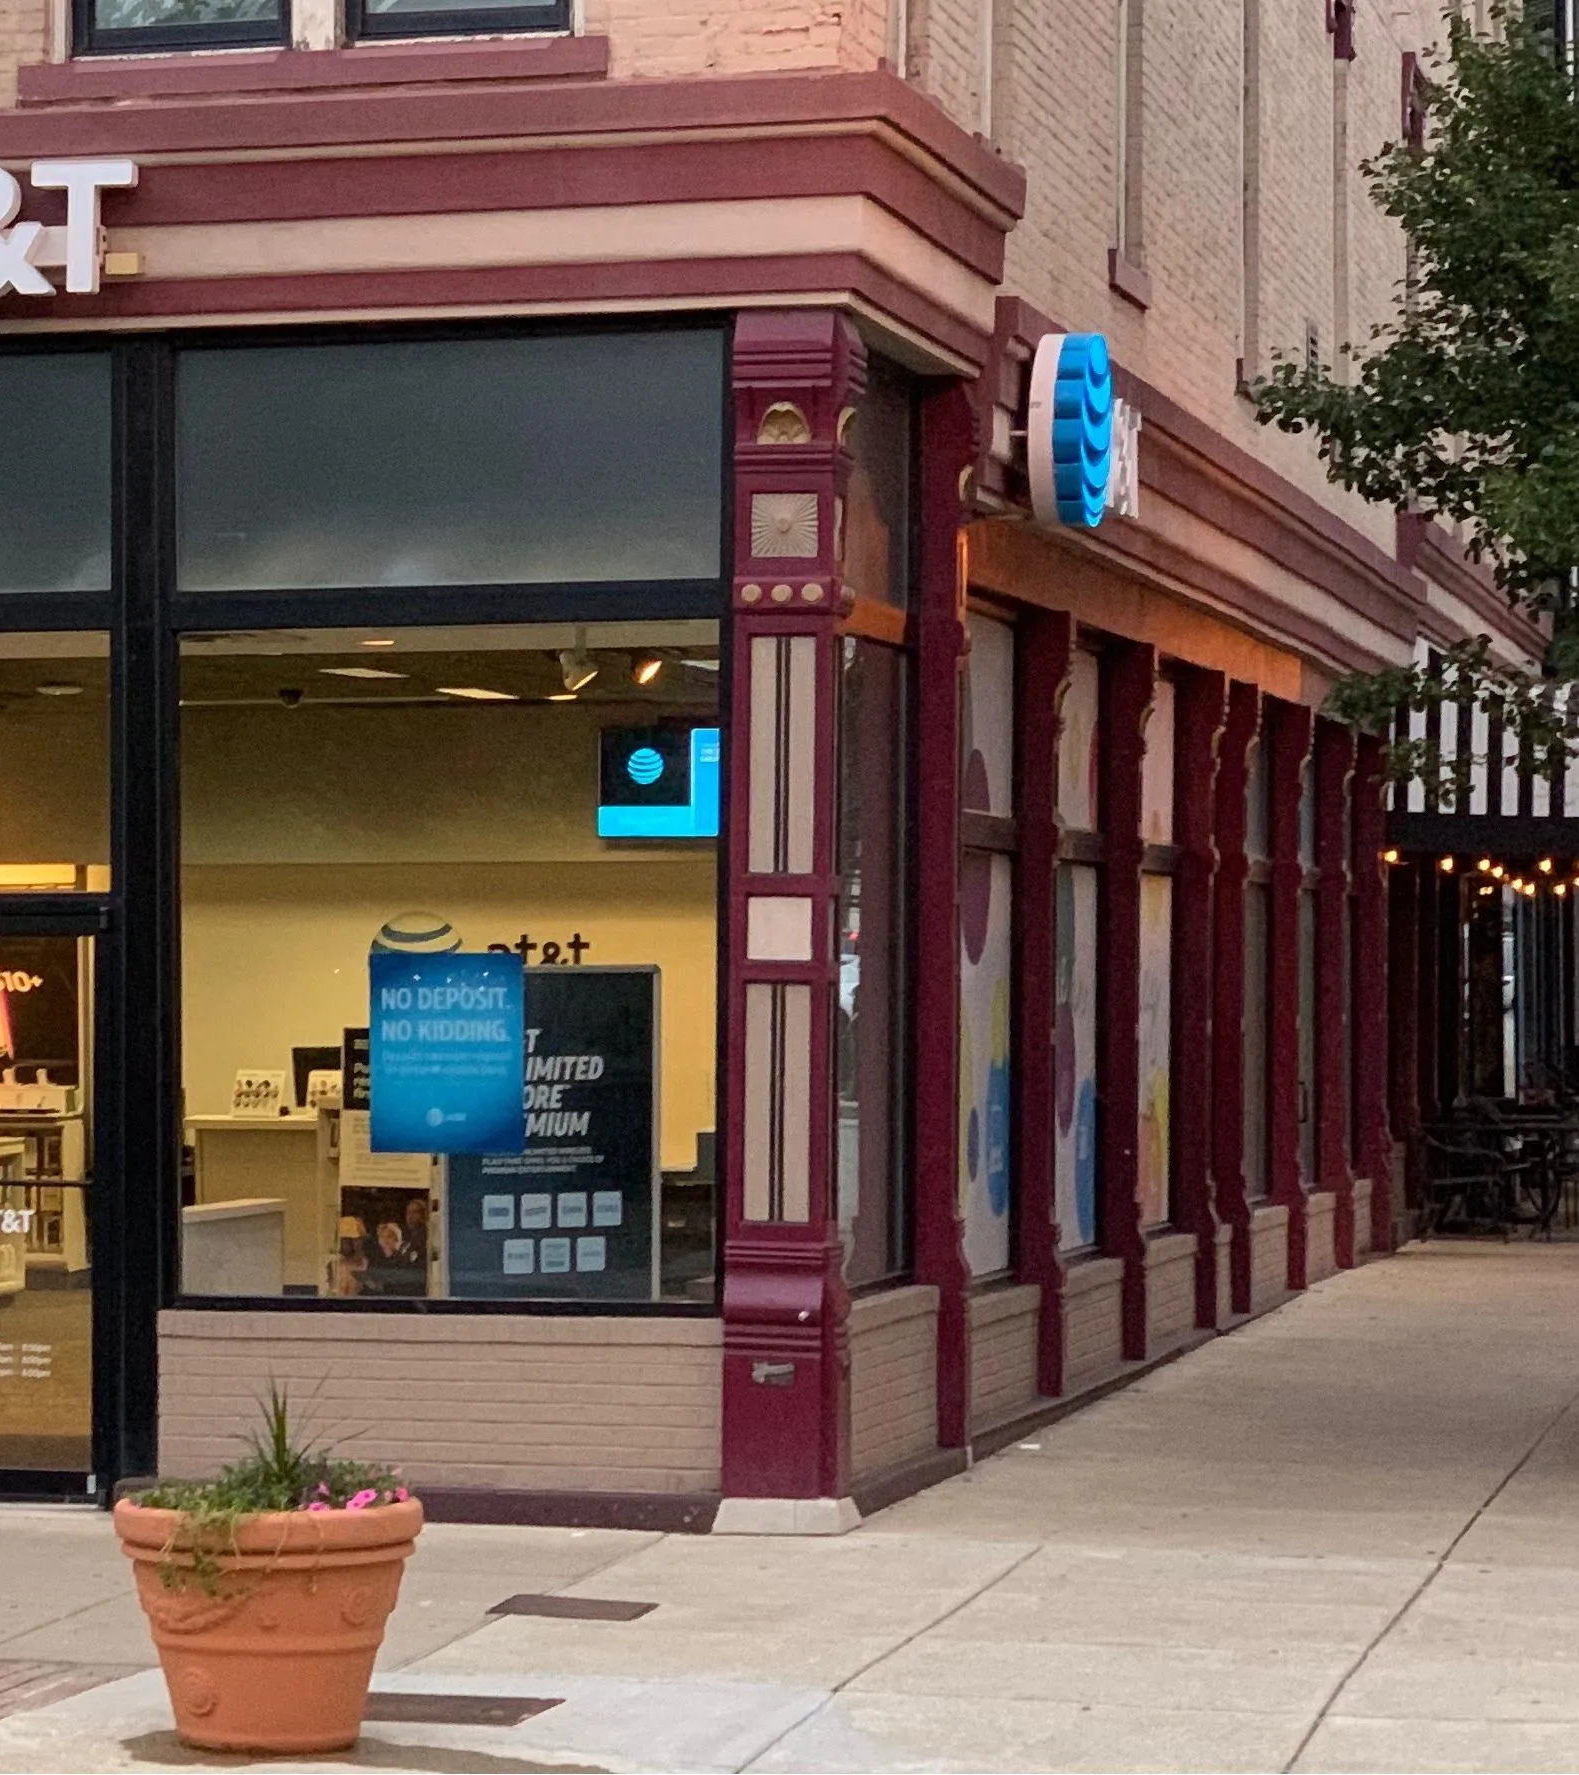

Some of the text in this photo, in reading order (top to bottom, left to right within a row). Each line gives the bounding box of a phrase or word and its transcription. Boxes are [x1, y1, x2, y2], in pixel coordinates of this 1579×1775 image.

[381, 987, 511, 1011] NO DEPOSIT.
[381, 1019, 511, 1042] NO KIDDING.
[525, 1055, 604, 1081] IMITED
[524, 1111, 591, 1137] MIUM
